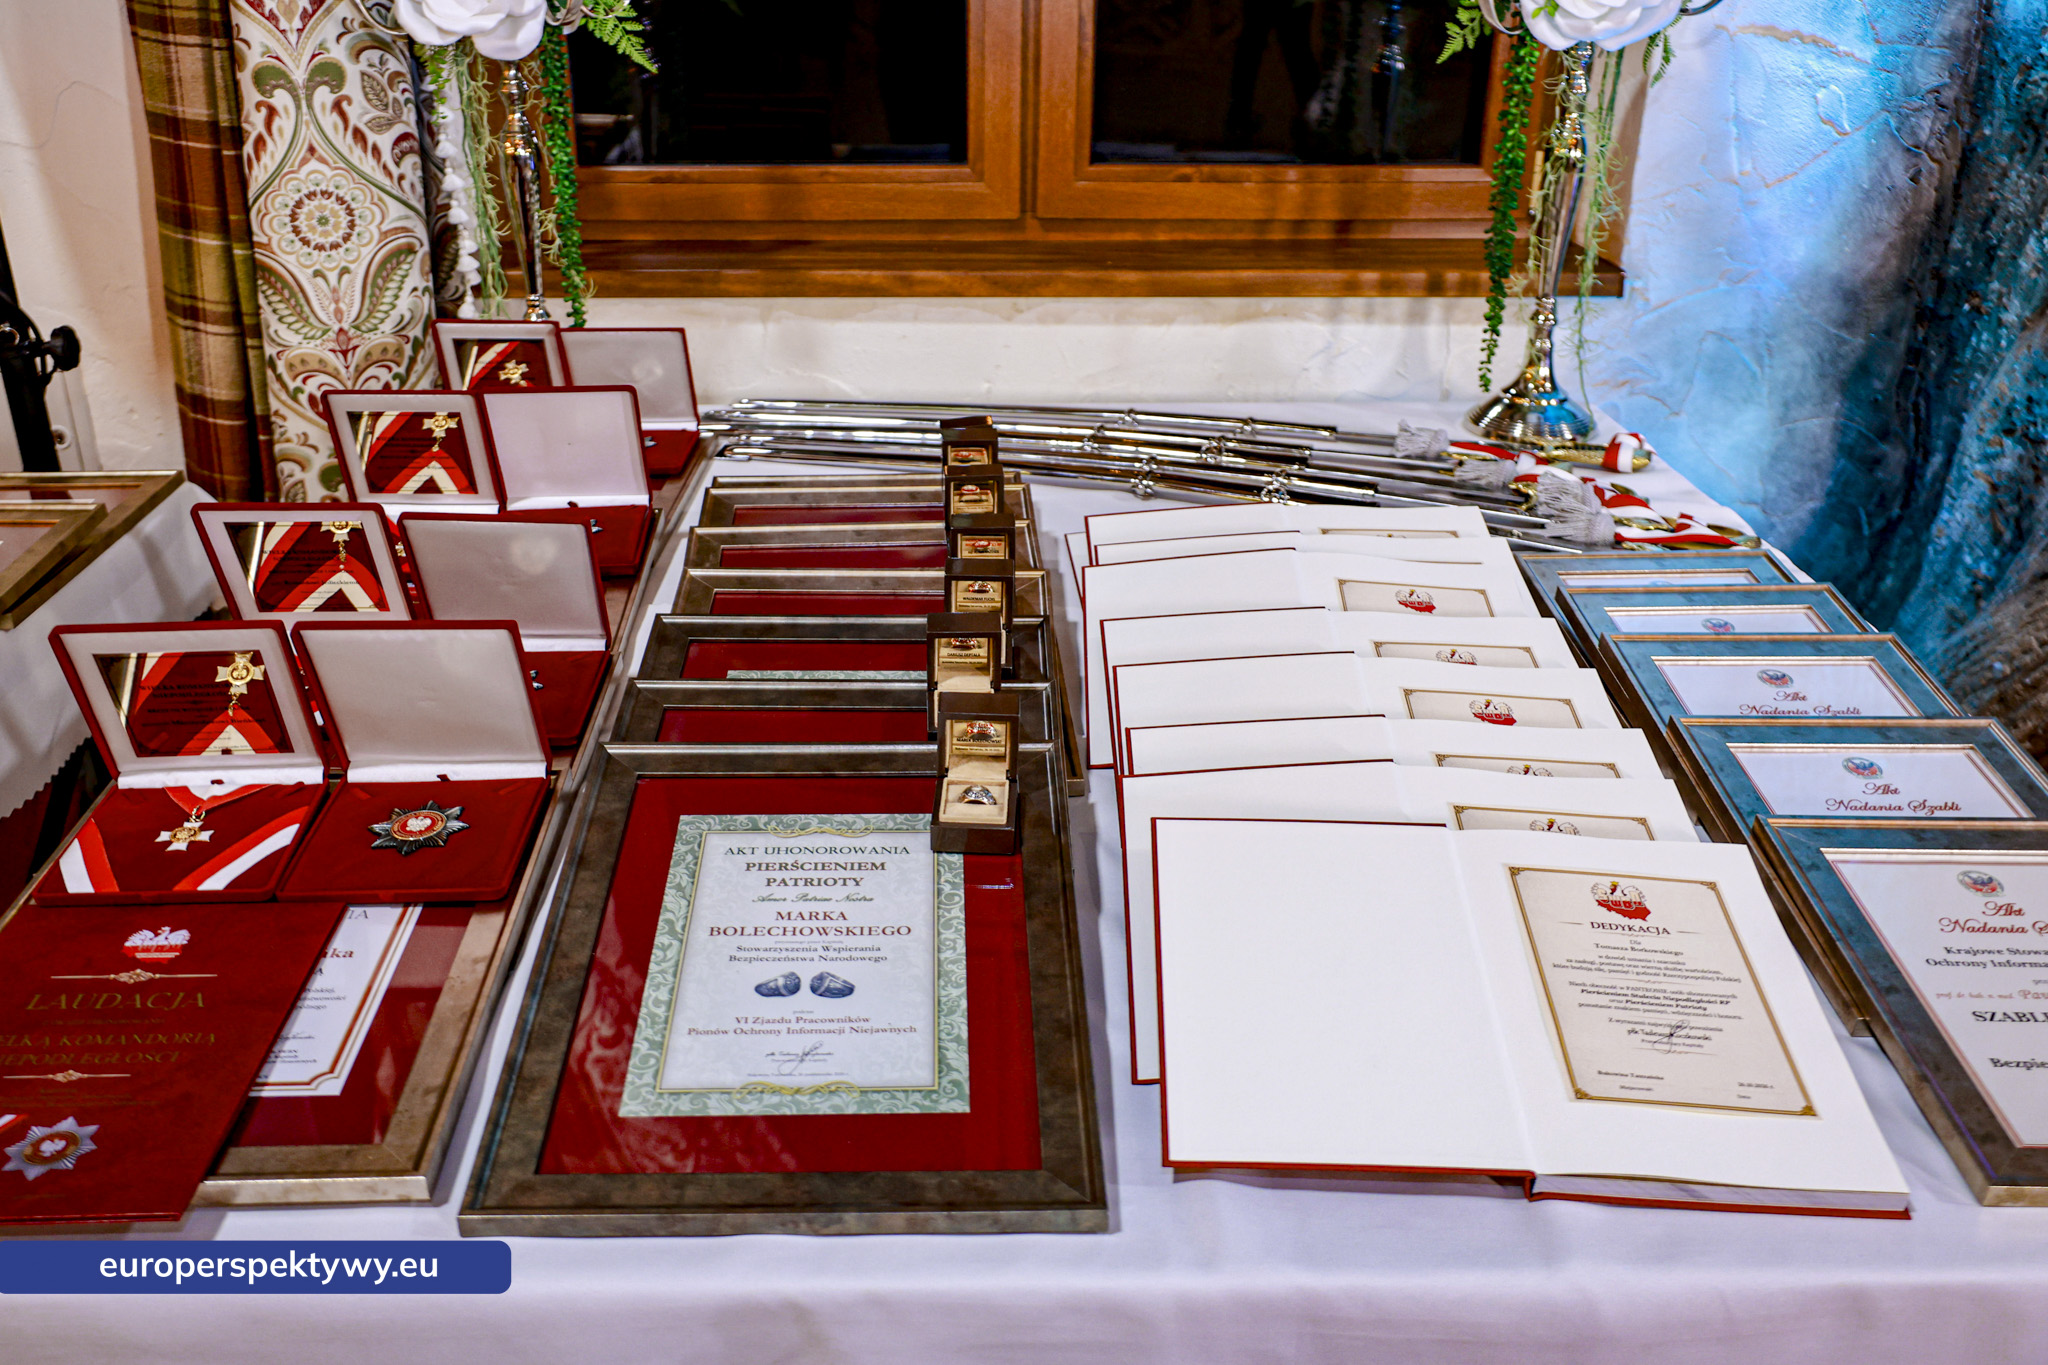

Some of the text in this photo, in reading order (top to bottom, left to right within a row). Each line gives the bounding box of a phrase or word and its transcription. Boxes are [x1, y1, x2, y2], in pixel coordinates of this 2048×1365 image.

[1773, 691, 1807, 701] Akt
[1739, 704, 1861, 716] Nadania Szabli
[1862, 782, 1900, 795] Akt
[1825, 798, 1962, 815] Nadania Szabli
[724, 846, 910, 855] AKT UHONOROWANIA
[745, 860, 886, 871] PIERŚCIENIEM
[765, 877, 864, 887] PATRIOTY
[1981, 900, 2026, 916] Akt
[775, 911, 848, 921] MARKA
[709, 925, 912, 936] BOLECHOWSKIEGO
[1590, 921, 1671, 936] DEDYKACJA
[1938, 917, 2029, 933] Nadania
[736, 945, 881, 953] Stowarzyszenia Wspierania
[1944, 946, 2005, 956] Krajowe
[729, 954, 888, 963] Bezpieczeństwa Narodowego
[1925, 958, 1987, 969] Ochrony
[26, 992, 204, 1011] LAUDACJA
[752, 1016, 792, 1025] Zjazdu
[795, 1016, 871, 1024] Pracowników
[687, 1026, 917, 1036] Pionów Ochrony Informacji Niejawnych
[0, 1051, 181, 1066] IEPODLEGŁOŚCI
